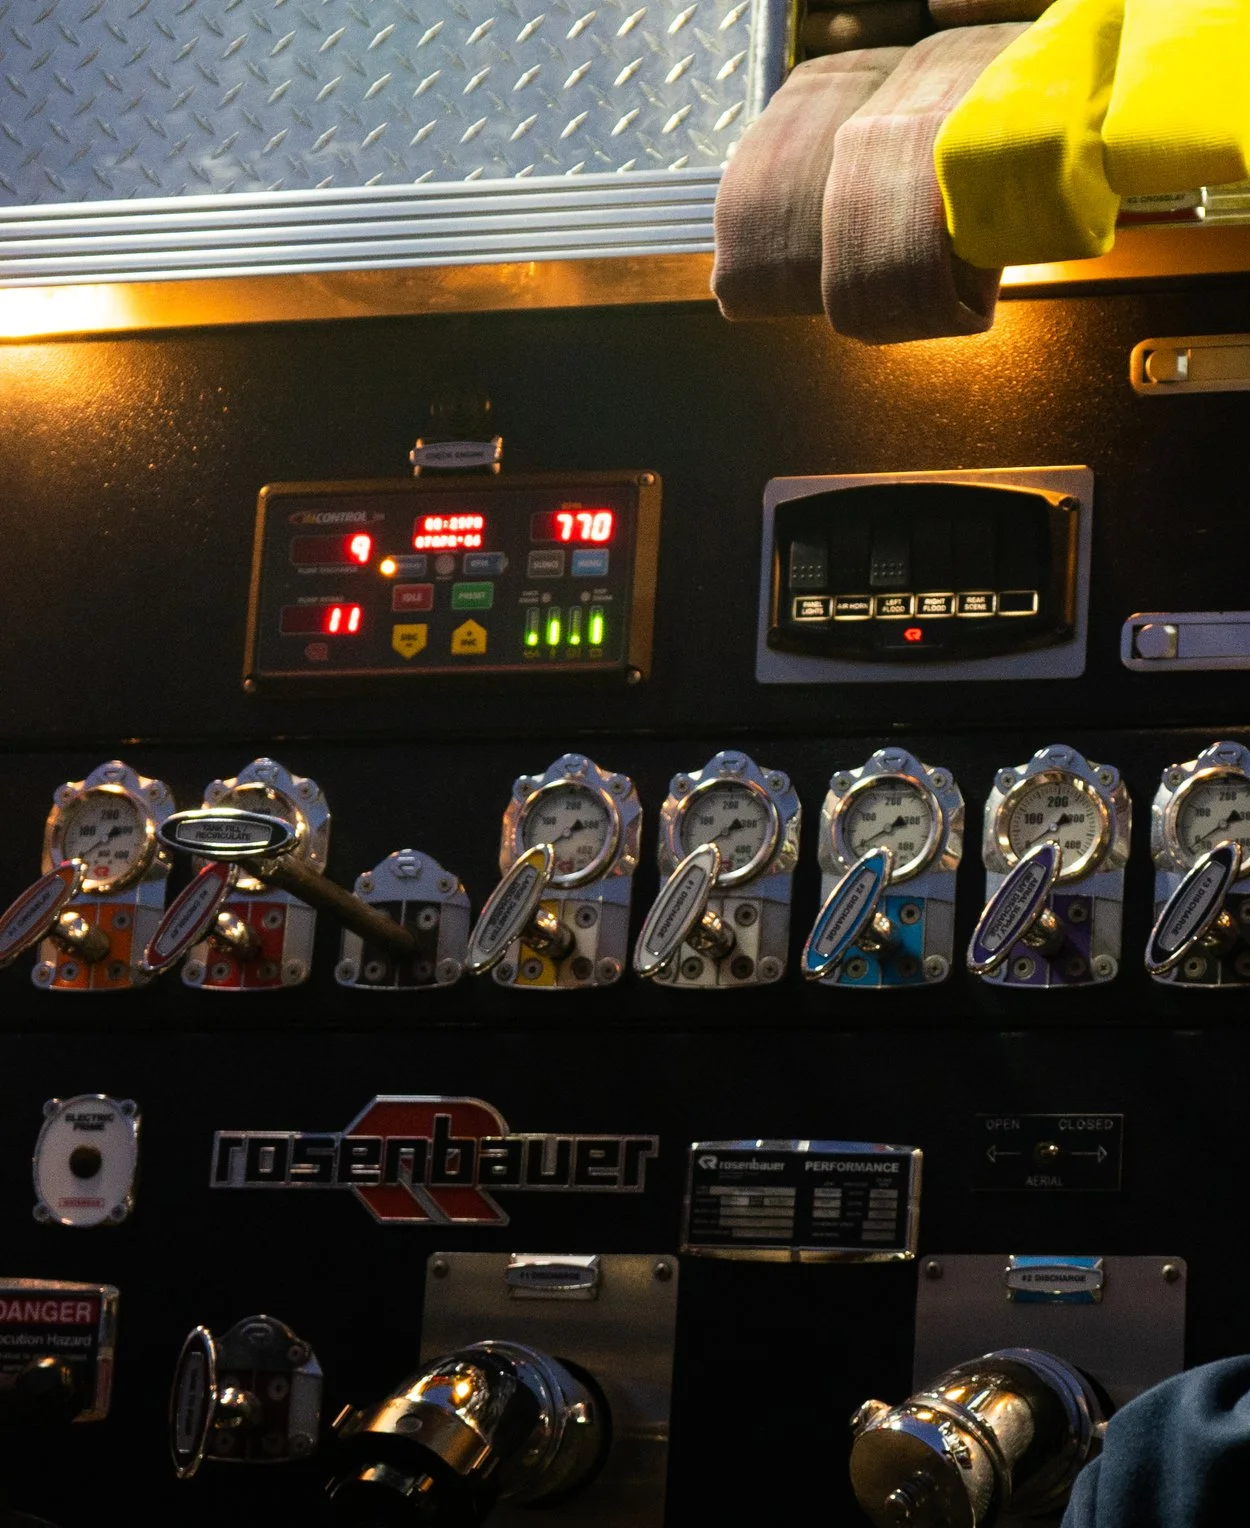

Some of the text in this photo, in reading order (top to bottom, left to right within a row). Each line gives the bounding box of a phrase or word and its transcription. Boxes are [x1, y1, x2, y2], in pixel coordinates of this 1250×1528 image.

[556, 512, 613, 542] 770
[350, 534, 371, 563] 9
[882, 605, 905, 613] FLOOD
[923, 604, 946, 612] FLOOD
[328, 606, 361, 633] 11
[1047, 795, 1069, 808] 200
[1024, 812, 1044, 824] 100
[1064, 840, 1082, 850] 400
[656, 889, 688, 939] DISCHARGE
[825, 892, 858, 942] DISCHARGE
[988, 891, 1020, 938] DISCHARGE
[998, 903, 1021, 935] SUPPLY
[1170, 886, 1205, 937] DISCHARGE
[64, 1112, 114, 1122] ELECTRIC
[985, 1117, 1114, 1130] OPEN CLOSED
[214, 1112, 660, 1191] rosenbauer
[719, 1156, 786, 1172] rosenbauer
[804, 1160, 900, 1173] PERFORMANCE
[1025, 1175, 1063, 1187] AERIAL
[1034, 1274, 1087, 1282] DISCHARGE
[47, 1332, 93, 1347] Hazard
